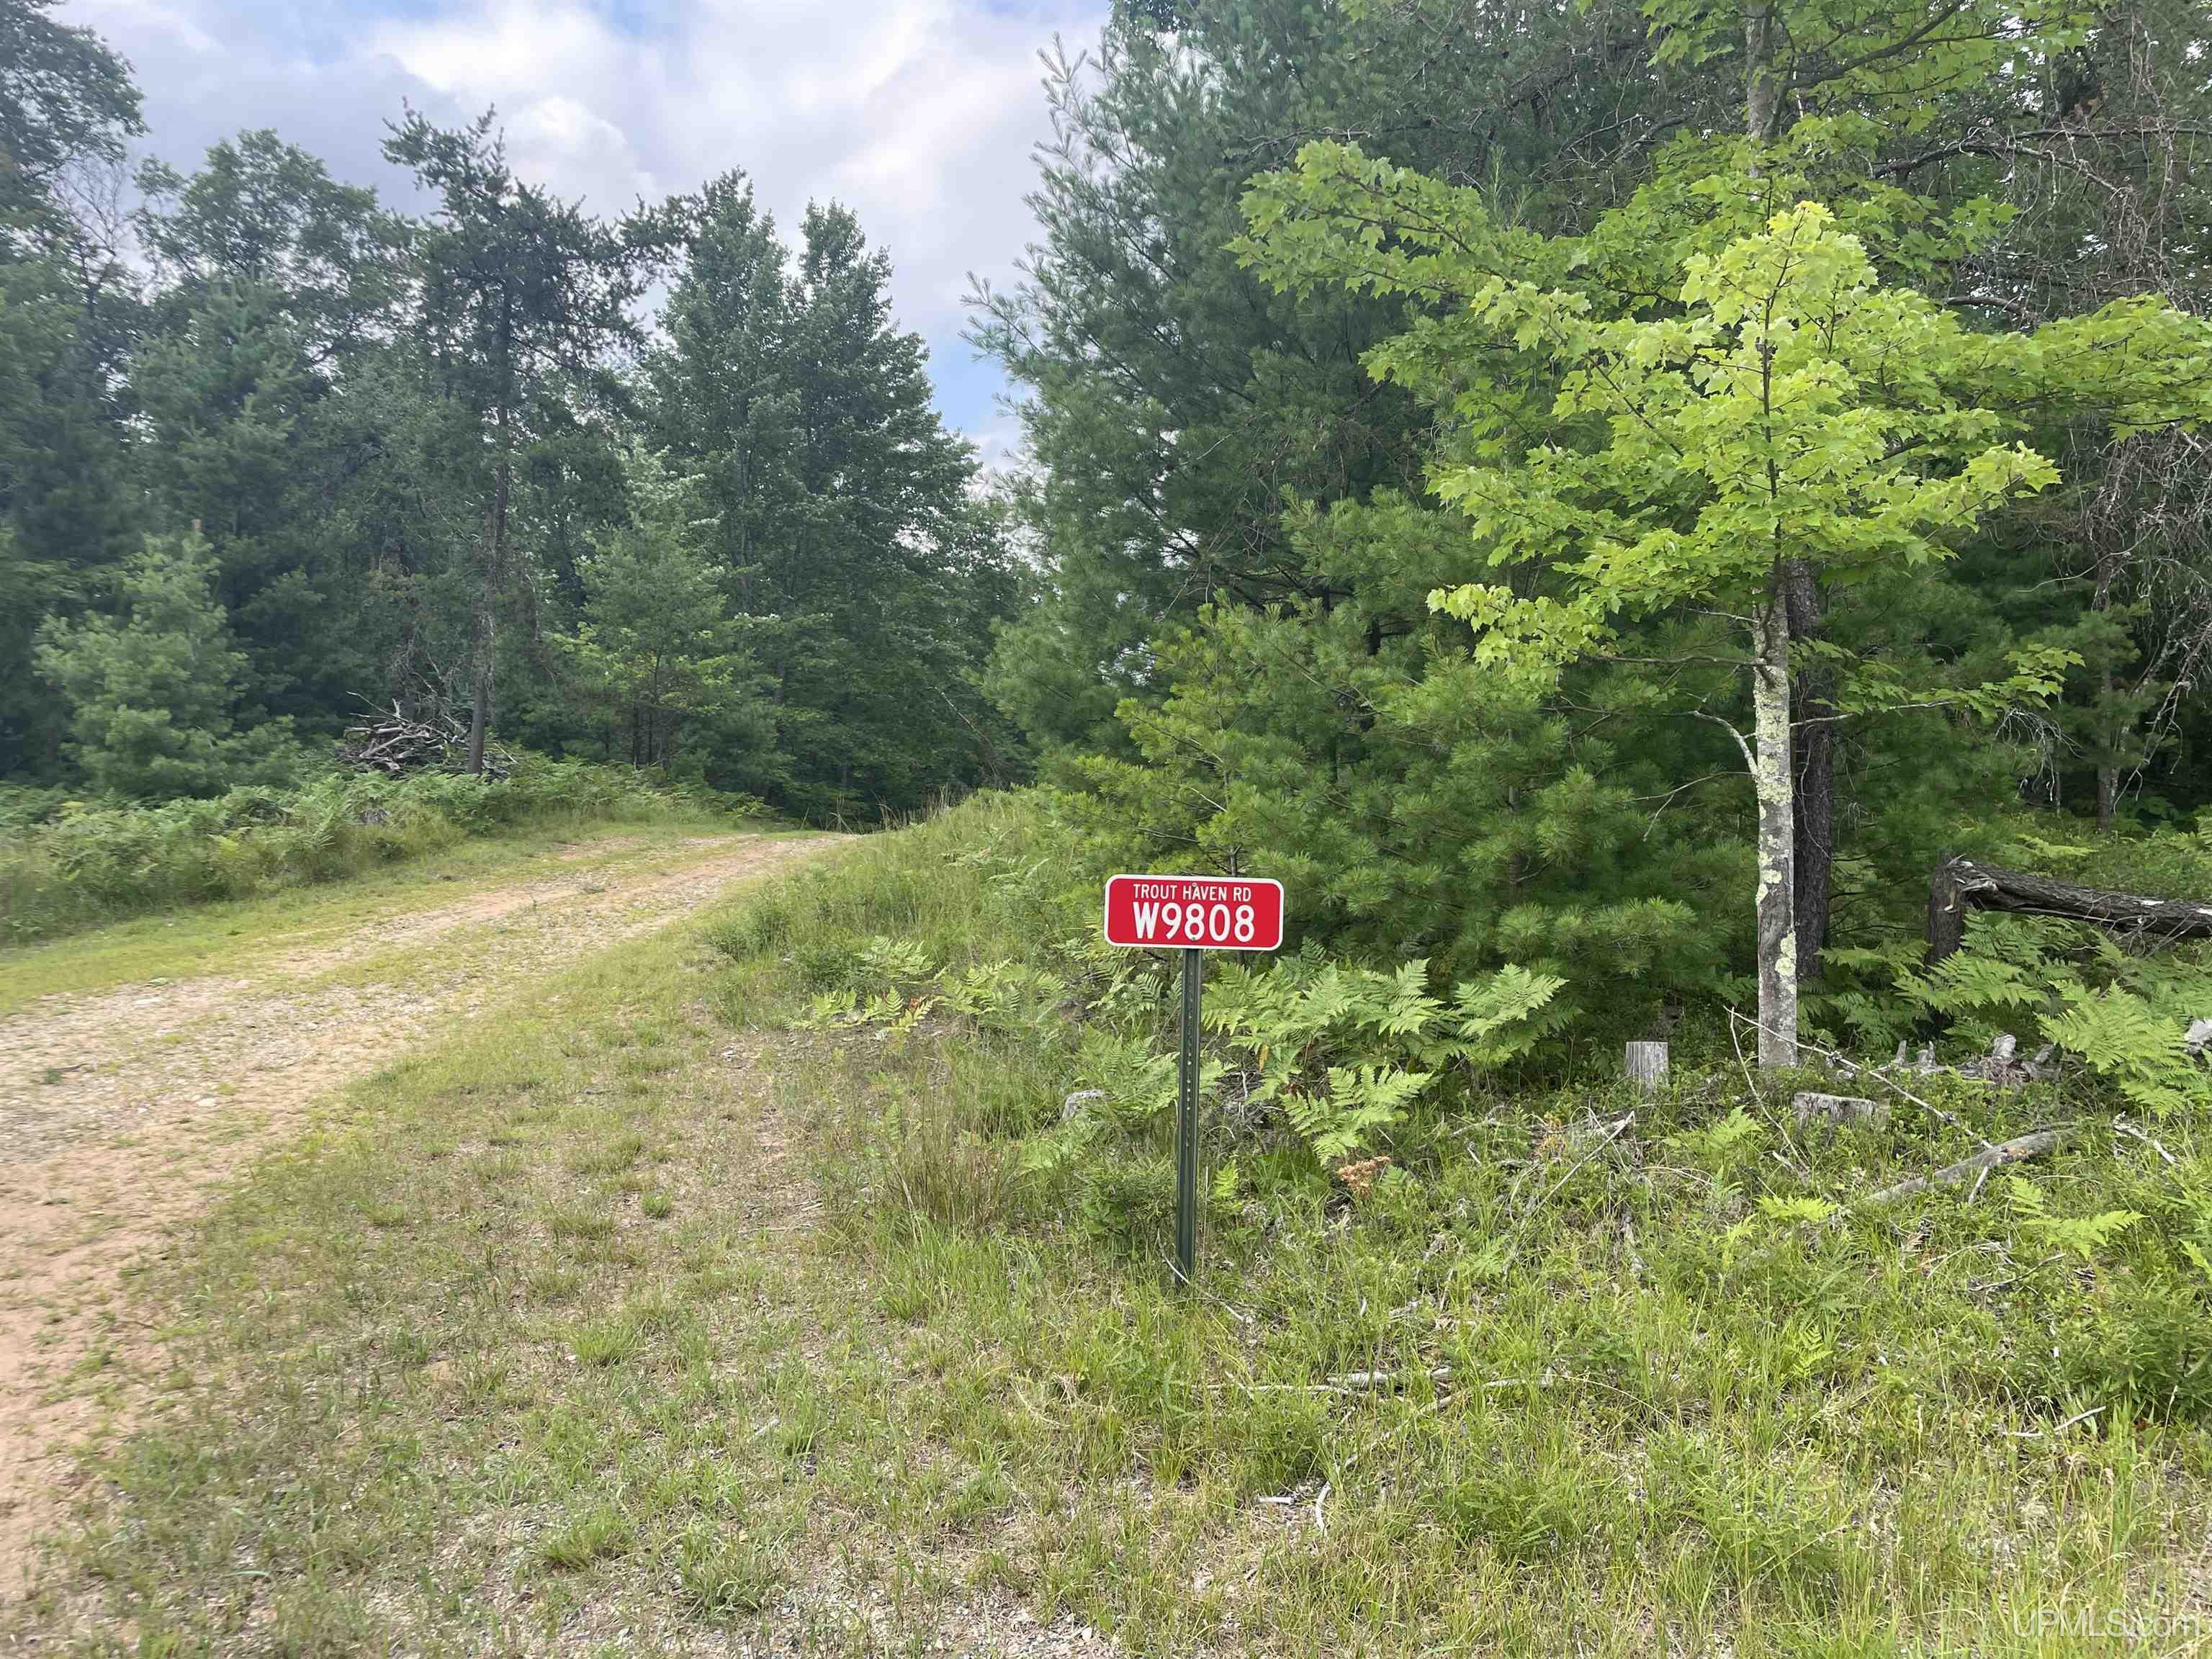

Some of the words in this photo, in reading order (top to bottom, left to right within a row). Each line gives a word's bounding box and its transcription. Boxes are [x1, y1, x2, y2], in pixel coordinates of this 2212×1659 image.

[1133, 884, 1177, 899] TROUT
[1182, 885, 1227, 902] HAVEN
[1233, 887, 1251, 902] RD
[1133, 902, 1254, 943] W9808
